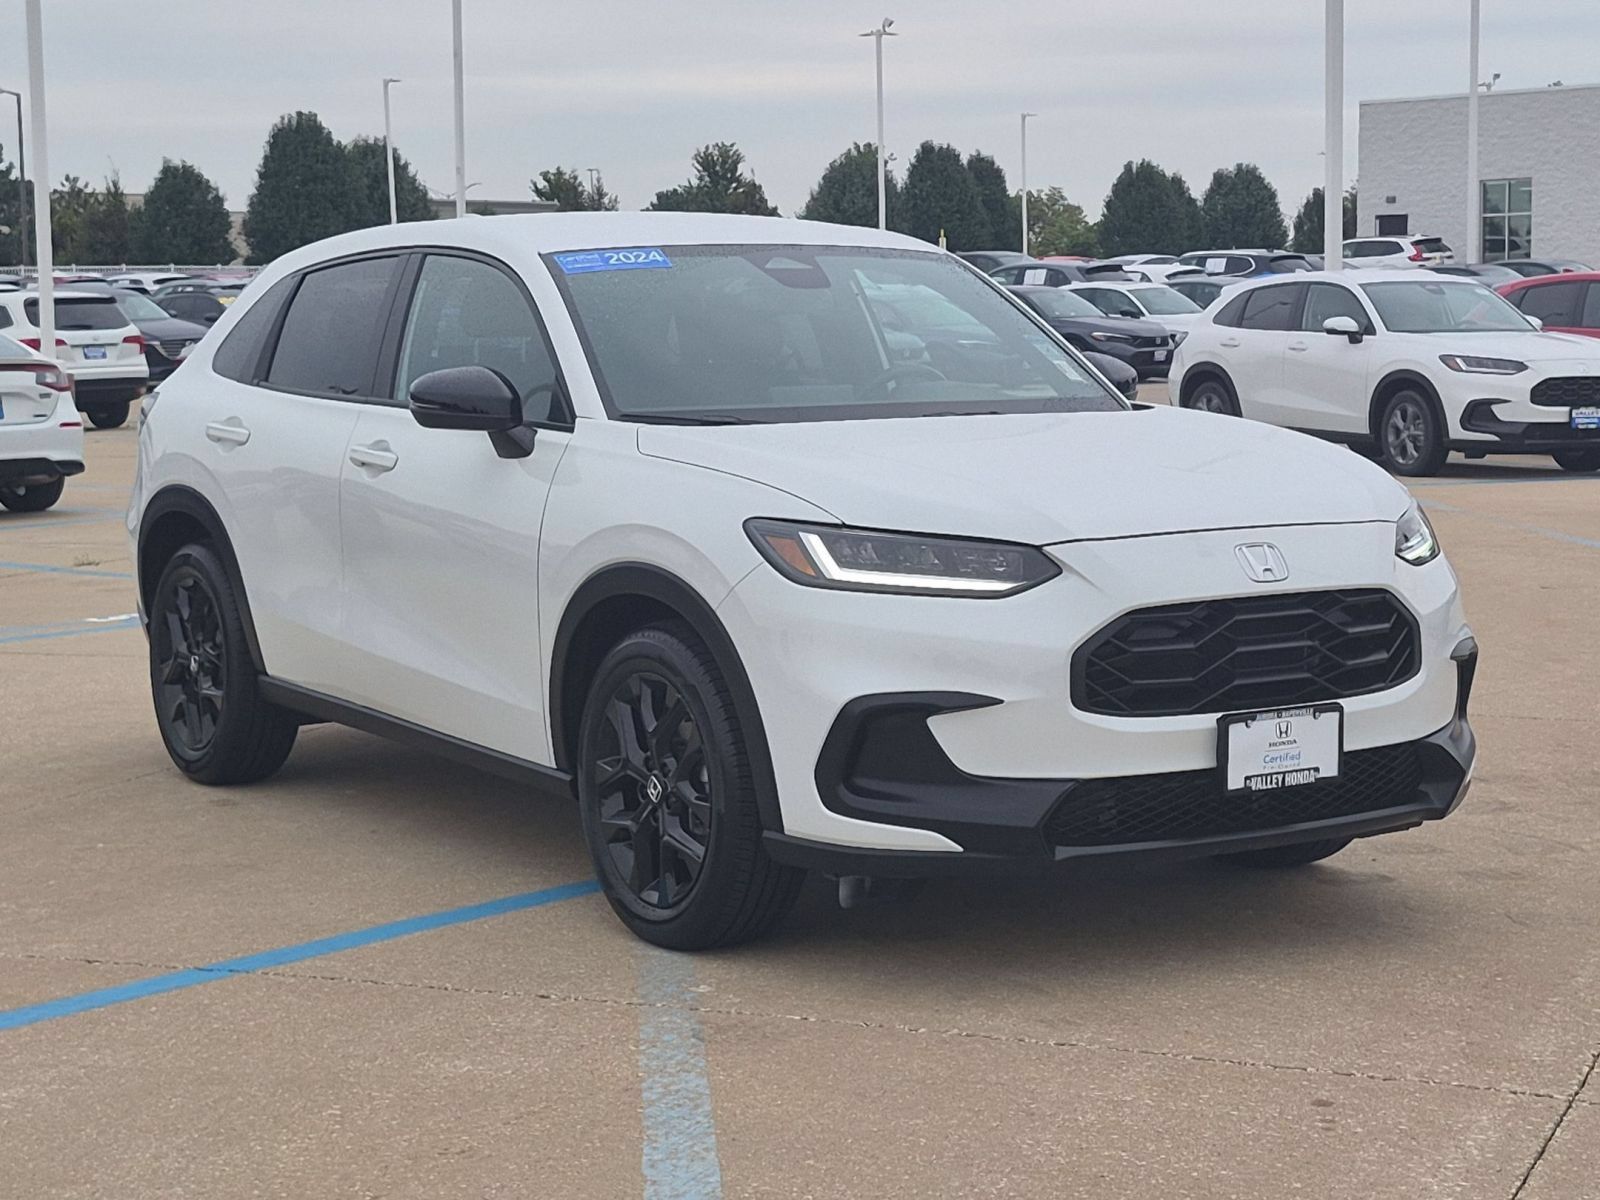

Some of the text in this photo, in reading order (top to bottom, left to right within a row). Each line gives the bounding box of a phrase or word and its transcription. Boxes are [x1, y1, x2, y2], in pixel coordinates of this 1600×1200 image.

[604, 251, 664, 264] 2024
[1268, 739, 1297, 748] HONDA
[1263, 751, 1301, 764] Certified
[1251, 770, 1315, 790] VALLEY HONDA
